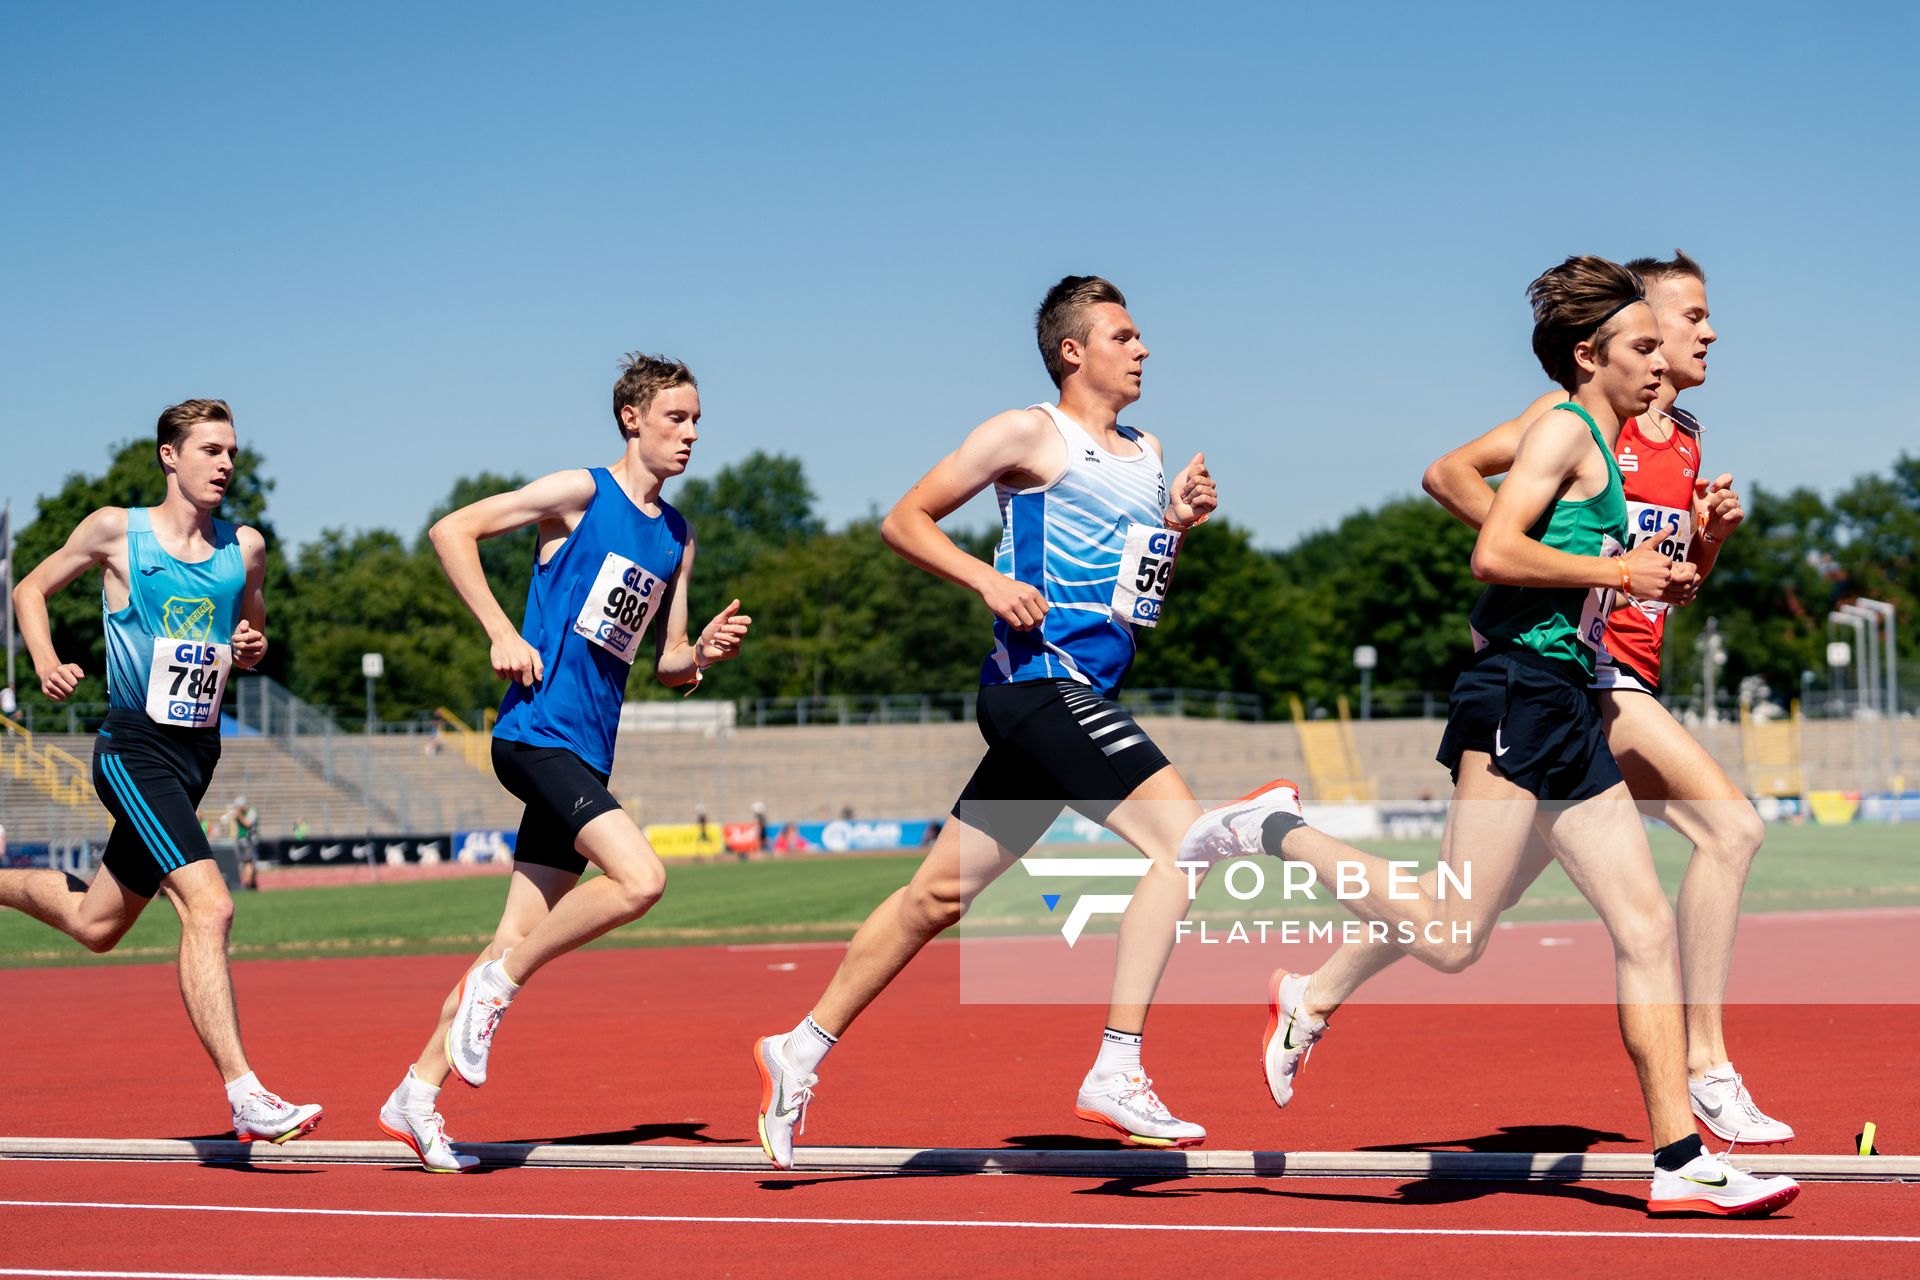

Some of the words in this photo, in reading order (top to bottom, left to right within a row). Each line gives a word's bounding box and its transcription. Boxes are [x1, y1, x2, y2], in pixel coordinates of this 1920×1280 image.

[1149, 533, 1179, 558] GL
[603, 587, 649, 632] 988
[168, 665, 219, 699] 784
